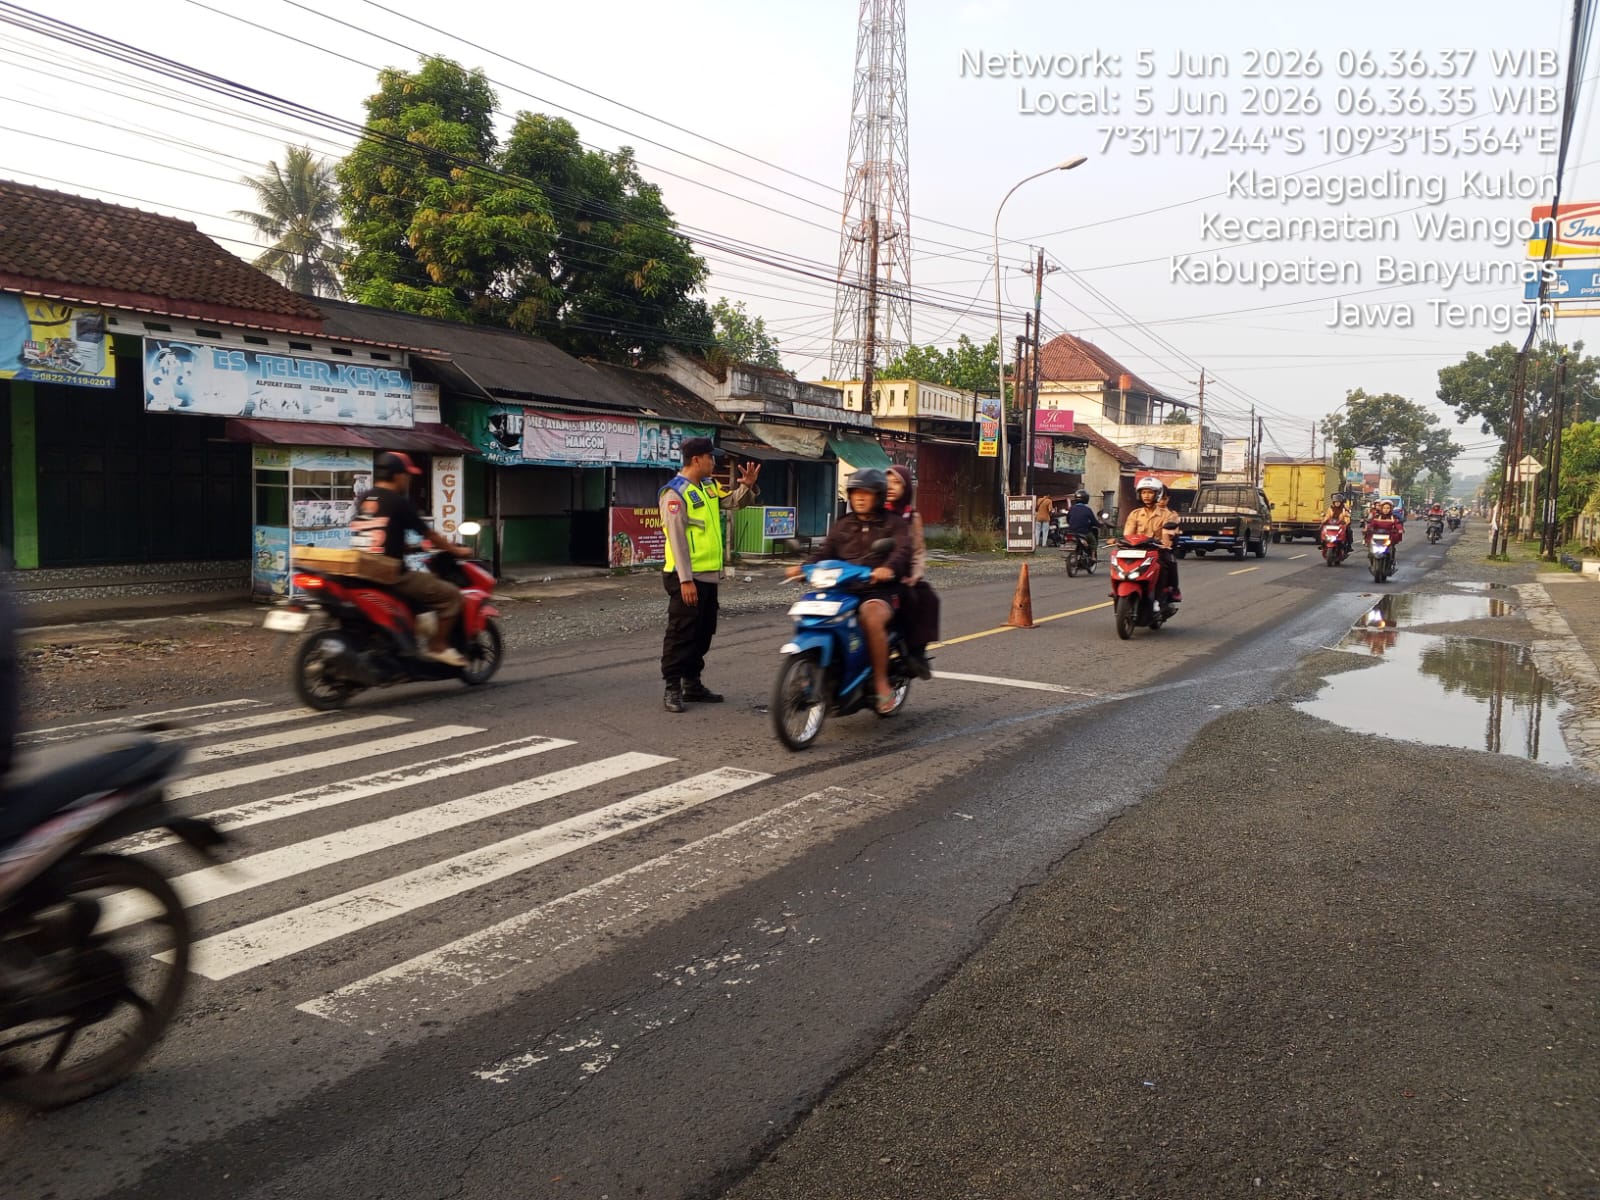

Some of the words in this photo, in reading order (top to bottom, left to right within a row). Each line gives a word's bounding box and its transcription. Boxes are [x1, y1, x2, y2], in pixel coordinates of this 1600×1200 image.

[213, 350, 249, 373] ES
[256, 354, 332, 385] TELER
[336, 364, 404, 390] KEY'S
[546, 418, 570, 431] AYAM
[579, 420, 606, 432] BAKSO
[565, 435, 605, 449] WANGON
